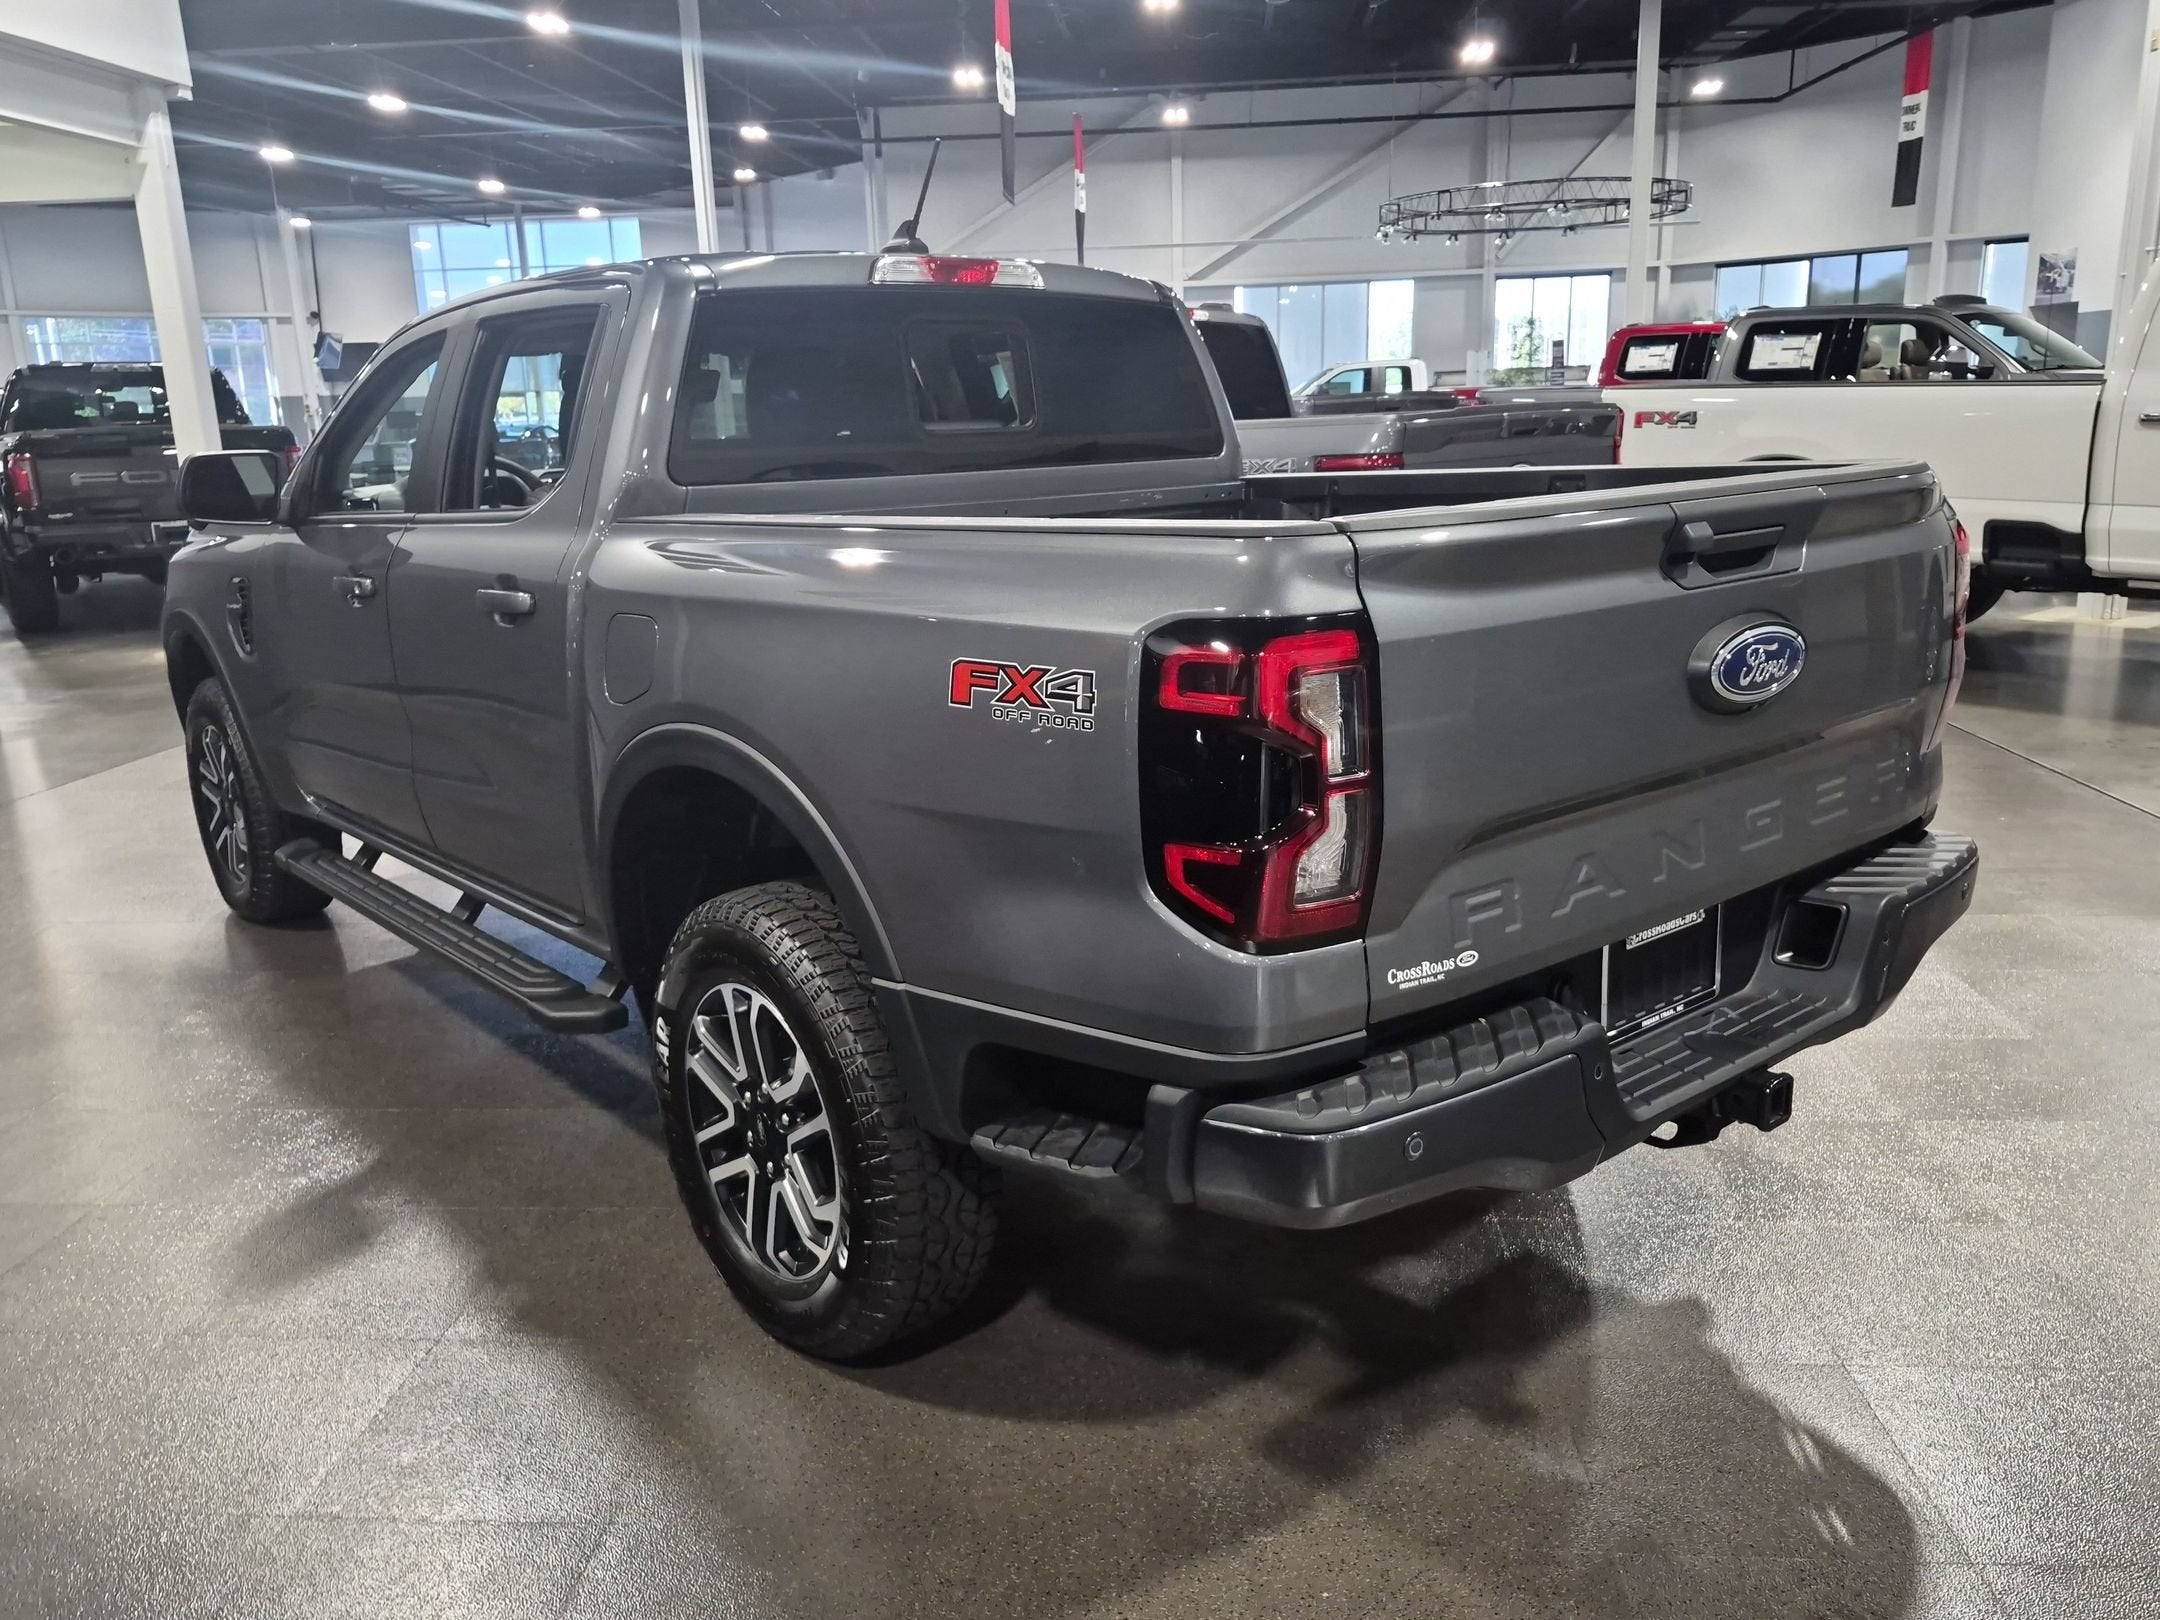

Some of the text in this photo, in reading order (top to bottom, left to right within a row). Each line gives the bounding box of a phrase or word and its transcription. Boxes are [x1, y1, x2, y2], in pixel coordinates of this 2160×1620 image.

[1634, 410, 1698, 428] FX4
[1242, 457, 1297, 475] X4
[1739, 641, 1791, 687] Ford
[948, 656, 1098, 717] FX4
[991, 706, 1095, 732] OFF ROAD
[1449, 758, 1904, 948] RANGER
